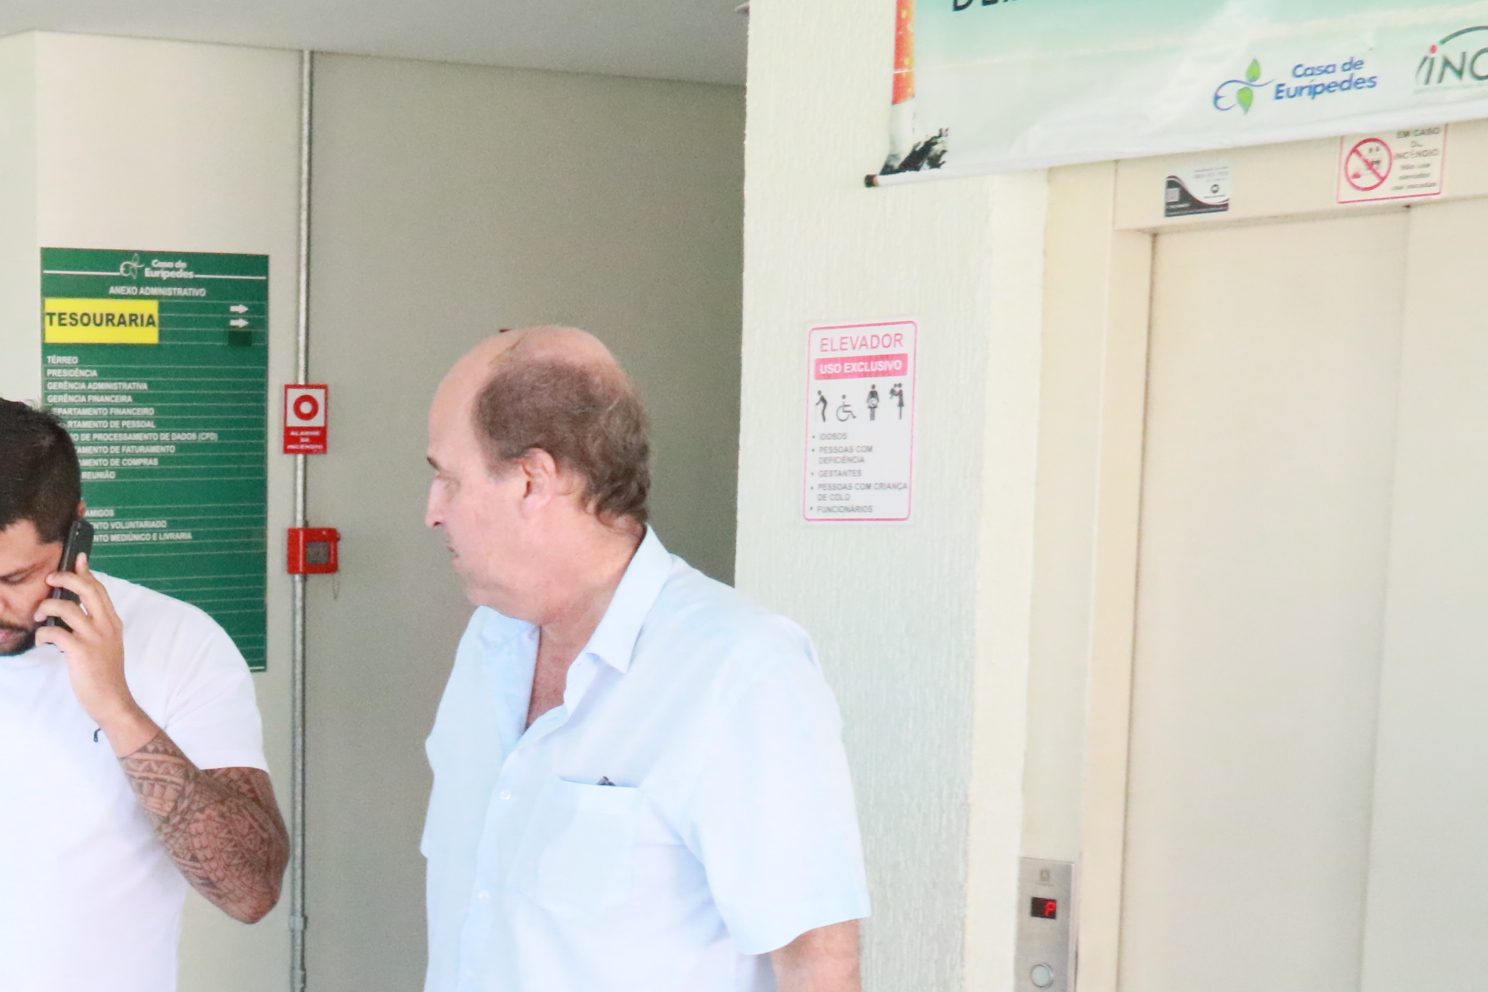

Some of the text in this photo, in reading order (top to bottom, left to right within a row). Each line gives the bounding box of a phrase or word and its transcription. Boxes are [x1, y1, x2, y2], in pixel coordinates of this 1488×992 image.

[1292, 57, 1365, 78] Casa de
[1274, 73, 1378, 100] Eurípedes
[1413, 127, 1440, 137] CASO
[151, 259, 187, 269] Casa de
[144, 267, 194, 280] Eurípedes
[108, 285, 206, 297] ANEXO ADMINISTRATIVO
[46, 312, 157, 327] TESOURARIA
[820, 333, 904, 352] ELEVADOR
[47, 355, 79, 364] TÉRREO
[820, 359, 902, 374] USO EXCLUSIVO
[47, 367, 98, 377] PRESIDÊNCIA
[47, 381, 148, 390] GERÊNCIA ADMINISTRATIVA
[47, 393, 133, 403] GERÊNCIA FINANCEIRA
[109, 407, 155, 416] FINANCEIRO
[110, 420, 120, 428] DE
[121, 420, 155, 428] PESSOAL
[80, 433, 91, 441] DE
[93, 433, 158, 441] PROCESSAMENTO
[159, 432, 170, 440] DE
[171, 432, 197, 440] DADOS
[819, 432, 847, 440] IDOSOS
[110, 445, 120, 453] DE
[121, 445, 176, 453] FATURAMENTO
[855, 445, 873, 453] COM
[110, 458, 120, 466] DE
[121, 458, 159, 466] COMPRAS
[818, 469, 862, 477] GESTANTES
[829, 493, 851, 501] COLO
[85, 509, 114, 517] AMIGOS
[110, 520, 167, 529] VOLUNTARIADO
[159, 532, 193, 540] LIVRARIA
